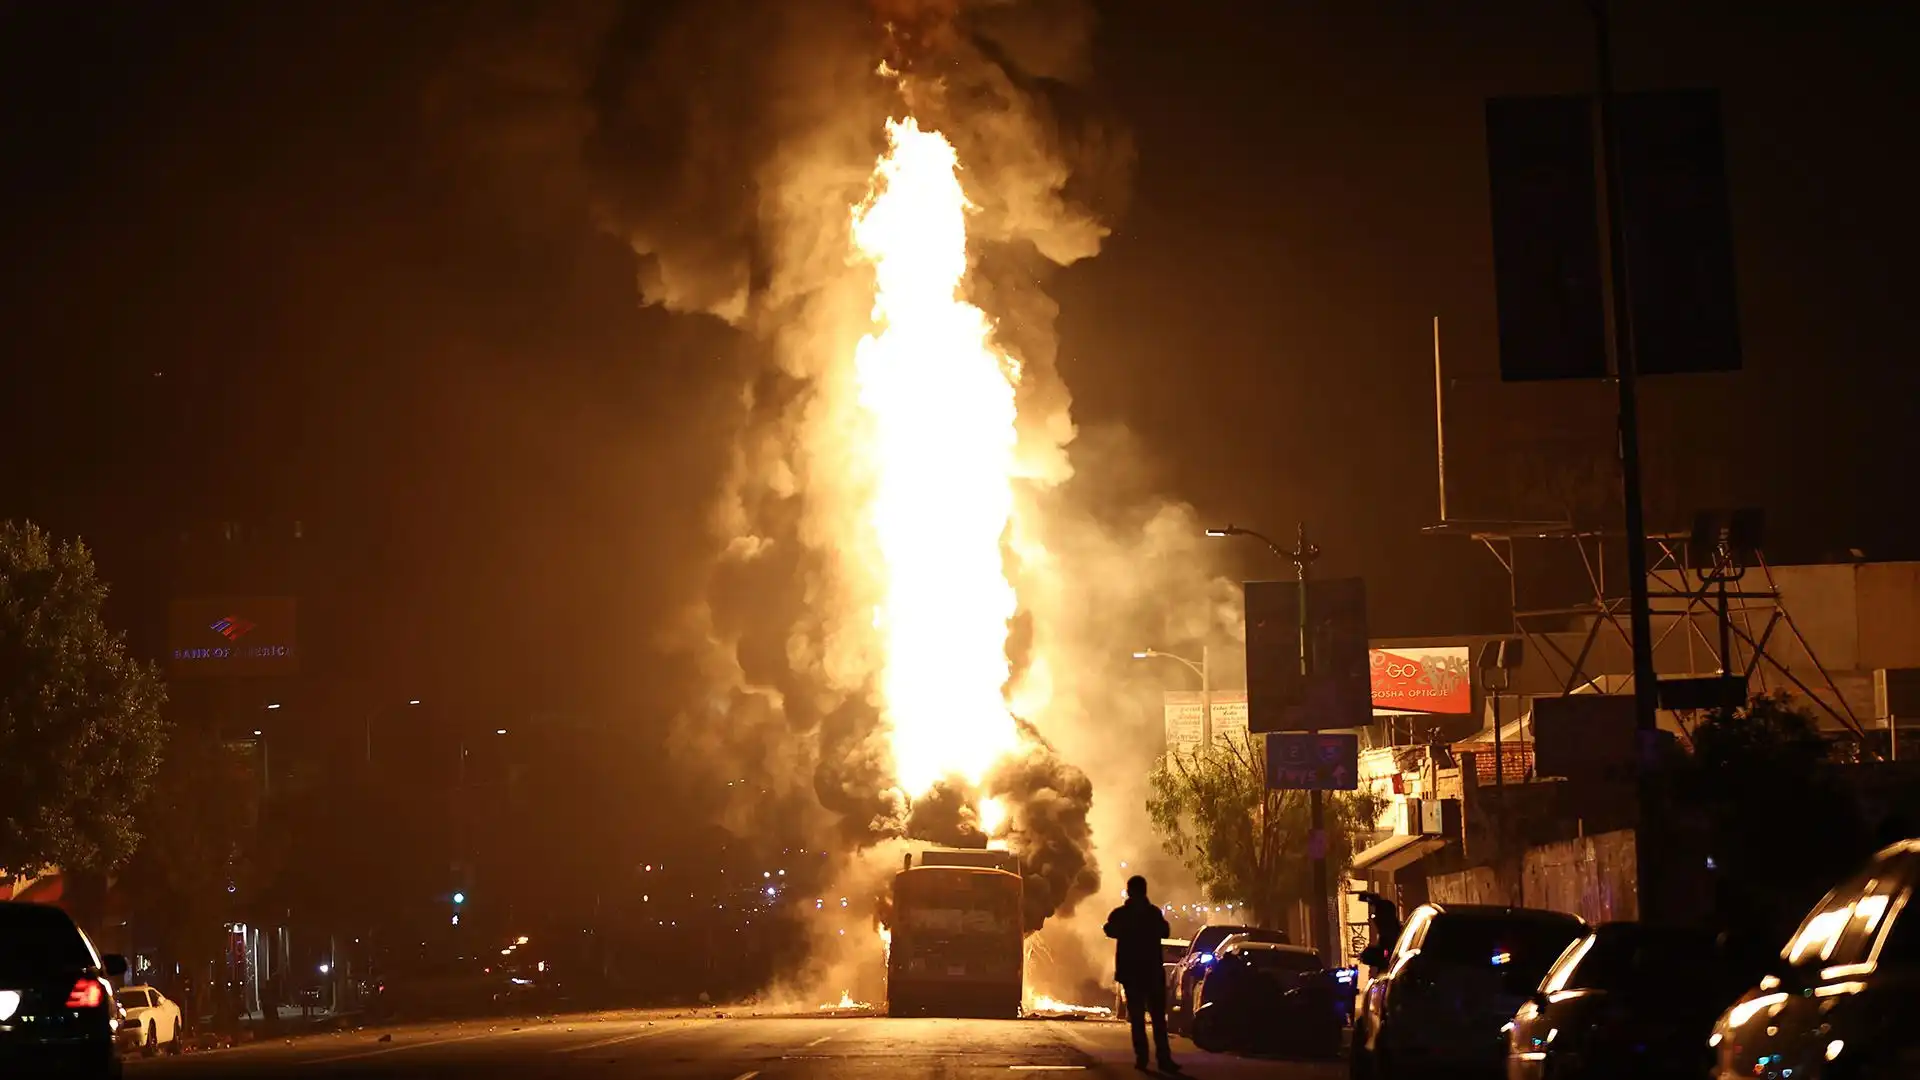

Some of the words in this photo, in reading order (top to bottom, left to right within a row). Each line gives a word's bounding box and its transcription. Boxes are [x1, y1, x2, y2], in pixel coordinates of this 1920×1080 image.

[174, 648, 210, 659] BANK
[213, 648, 230, 658] OF
[1387, 663, 1416, 678] GO
[1371, 690, 1404, 699] GOSHA
